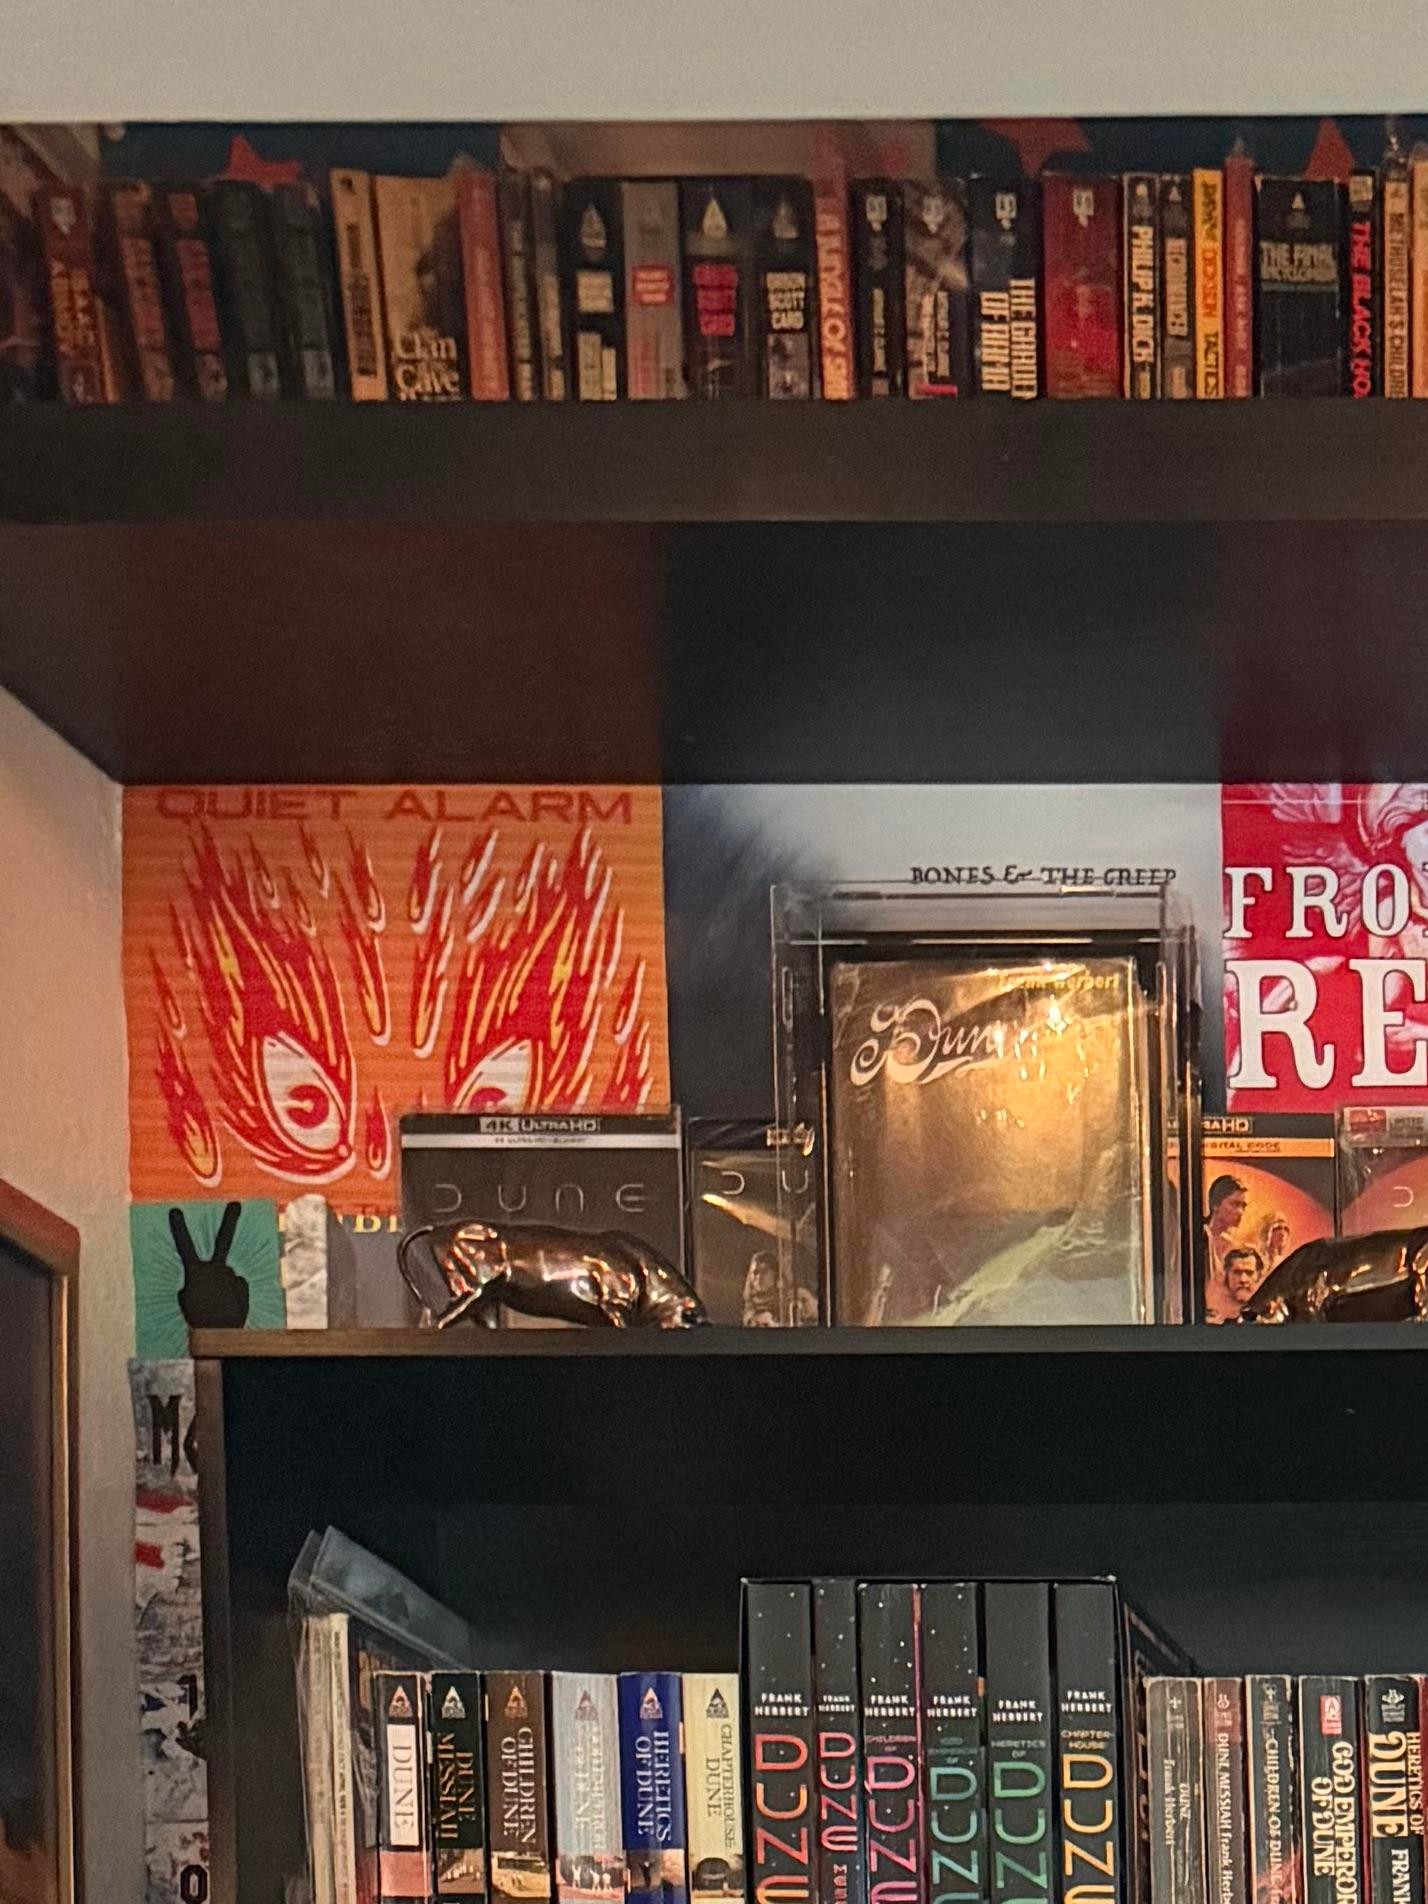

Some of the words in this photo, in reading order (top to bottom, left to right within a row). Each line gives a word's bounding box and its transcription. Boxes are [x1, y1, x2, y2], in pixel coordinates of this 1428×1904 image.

[155, 789, 356, 820] QUIET
[386, 789, 633, 826] ALARM
[910, 866, 996, 887] BONES
[437, 1731, 459, 1841] MESSIAH
[651, 1730, 671, 1842] HERETICS
